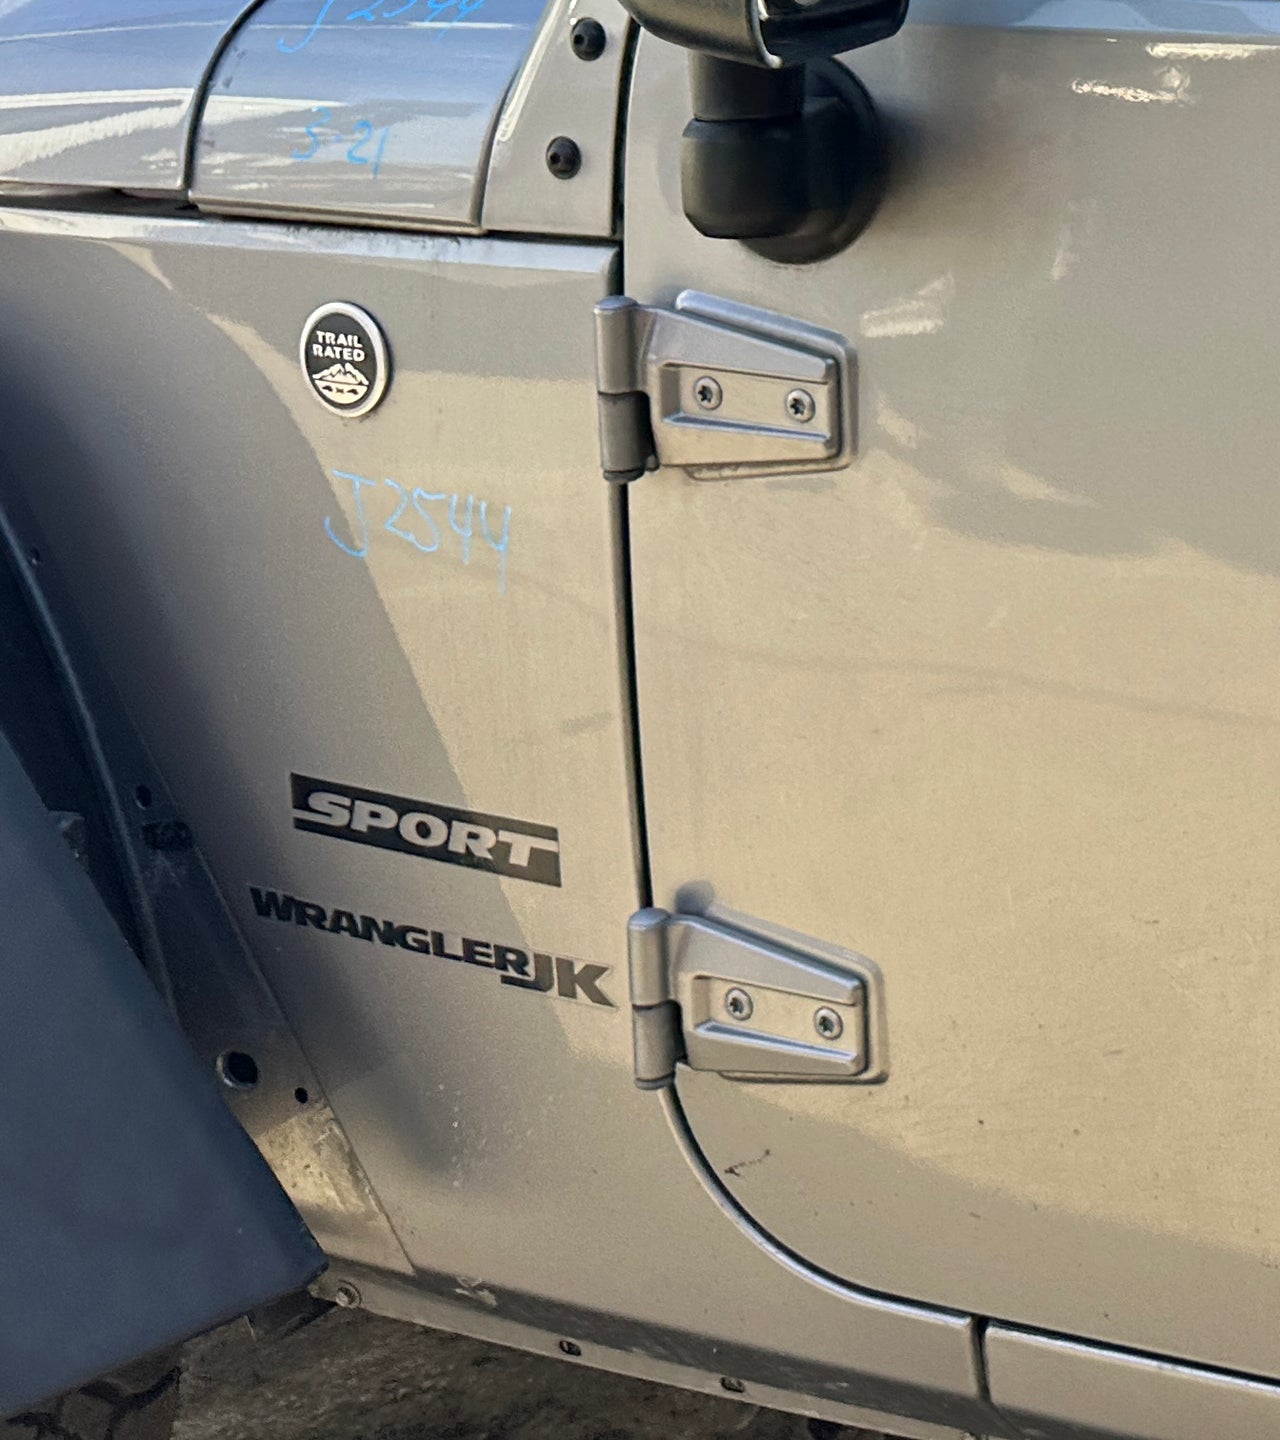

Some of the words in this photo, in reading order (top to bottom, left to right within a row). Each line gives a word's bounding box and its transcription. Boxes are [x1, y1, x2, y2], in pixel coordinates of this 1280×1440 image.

[311, 343, 366, 362] RATED
[315, 330, 363, 348] TRAIL
[323, 468, 512, 593] J2544
[293, 790, 559, 868] SPORT
[248, 886, 533, 979] WRANGLER
